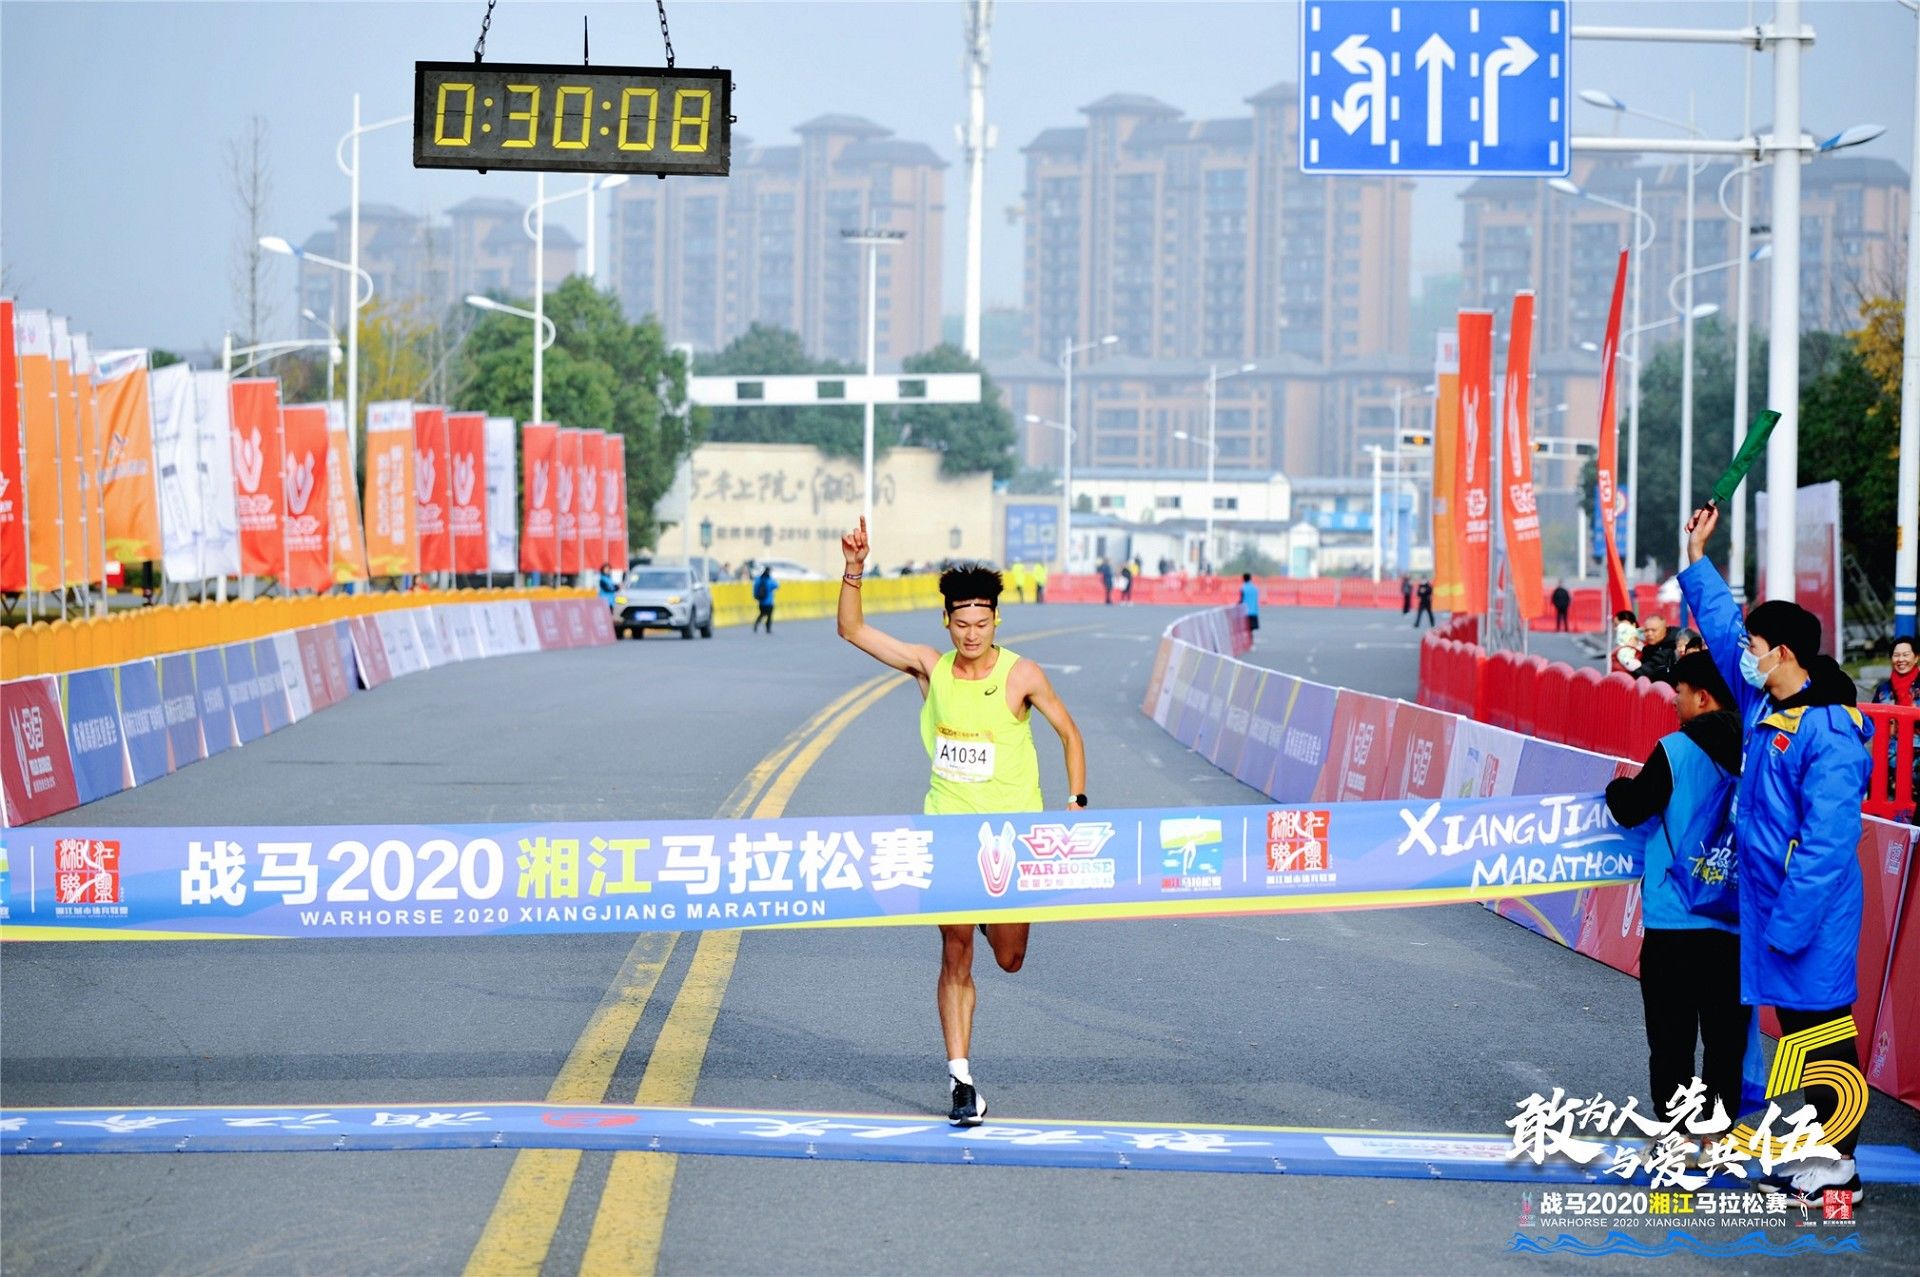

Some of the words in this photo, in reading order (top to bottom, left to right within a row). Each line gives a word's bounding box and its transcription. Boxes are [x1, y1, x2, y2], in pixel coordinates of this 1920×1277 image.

[433, 82, 712, 152] 0:30:08
[940, 744, 987, 764] A1034
[1397, 796, 1620, 856] XIANGJIAN
[179, 828, 934, 906] 战马2020湘江马拉松赛
[1020, 864, 1054, 876] WAR
[1058, 861, 1112, 874] HORSE
[1471, 851, 1634, 893] MARATHON
[300, 909, 443, 926] WARHORSE
[454, 908, 509, 923] 2020
[520, 903, 676, 922] XIANGJIANG
[687, 900, 826, 919] MARATHON
